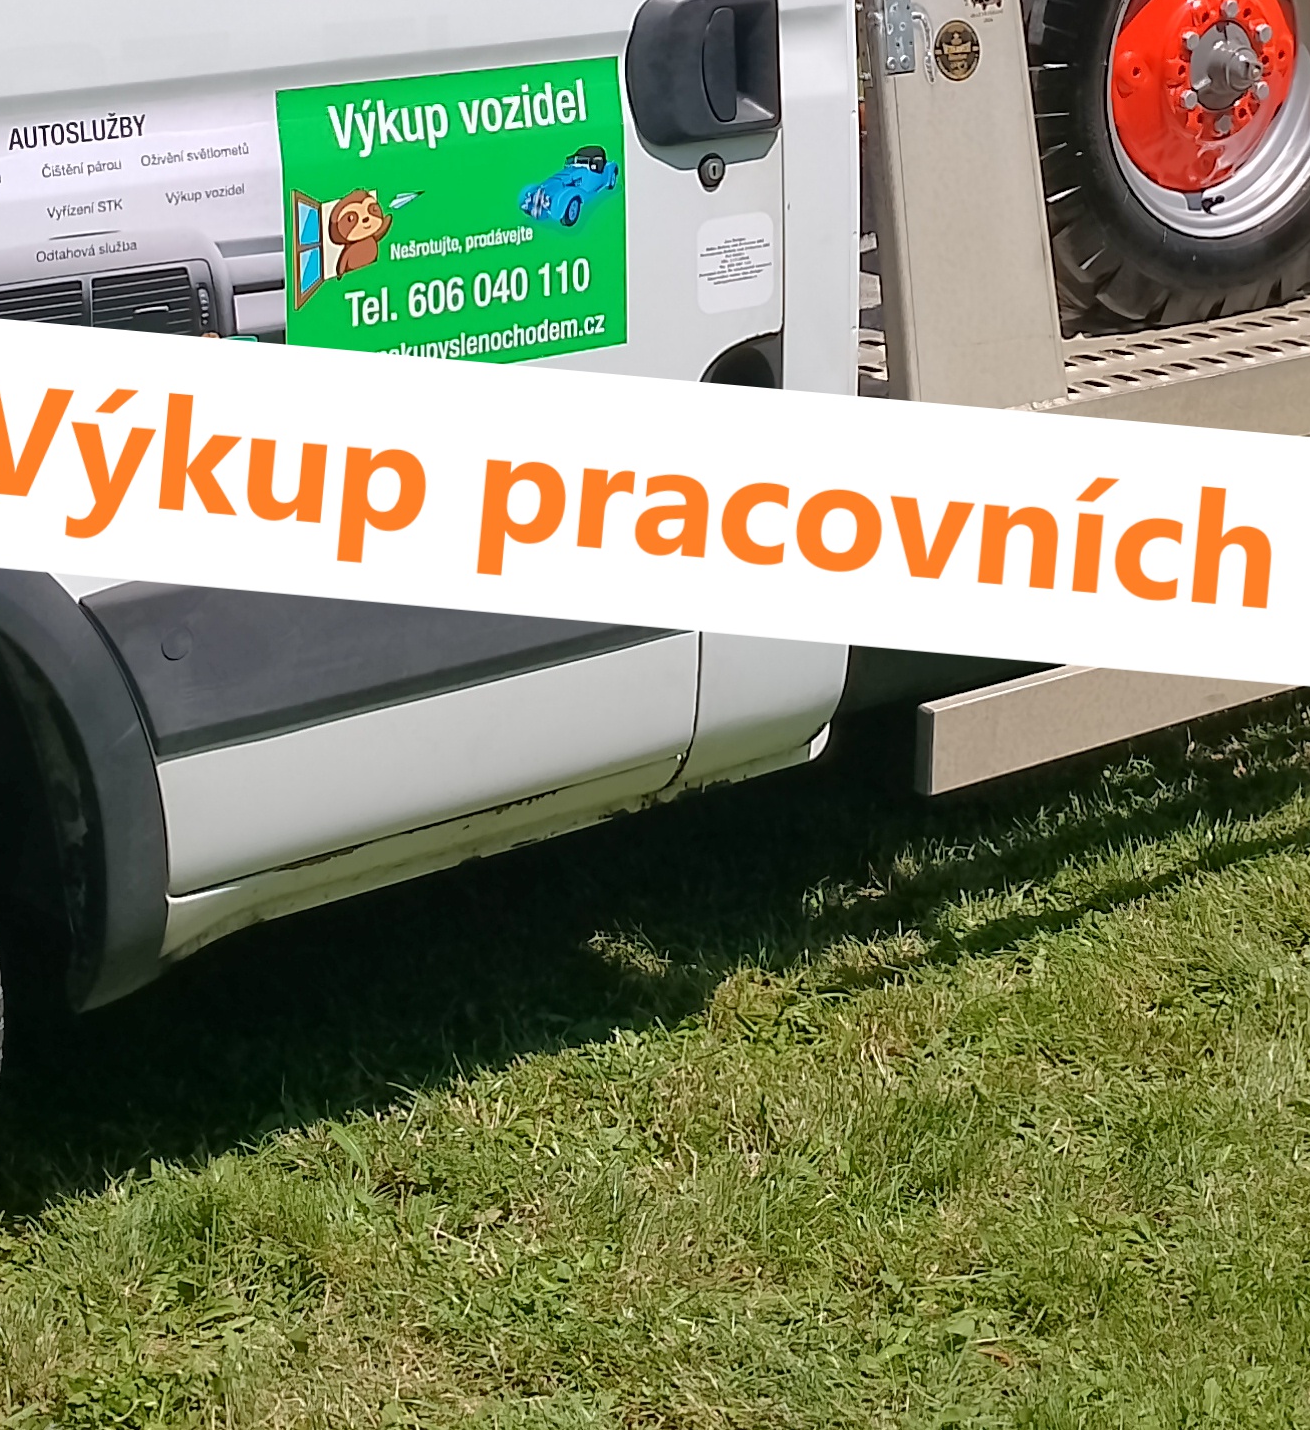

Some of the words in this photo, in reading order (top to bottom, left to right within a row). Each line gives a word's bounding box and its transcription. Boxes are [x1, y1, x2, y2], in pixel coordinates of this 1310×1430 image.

[8, 113, 146, 151] AUTOSLUŽBY
[327, 97, 449, 158] Výkup
[458, 78, 587, 136] vozidel
[41, 161, 84, 179] Čištění
[87, 159, 122, 176] párou
[140, 149, 184, 168] Oživění
[186, 142, 250, 163] světlometů
[46, 201, 94, 220] Vyřízení
[97, 198, 123, 215] STK
[165, 188, 202, 206] Výkup
[204, 182, 245, 200] vozidel
[36, 244, 96, 263] Odtahová
[99, 239, 138, 256] služba
[390, 235, 463, 261] Nešrotujte,
[465, 225, 533, 252] prodávejte
[344, 286, 398, 328] Tel.
[408, 279, 465, 319] 606
[473, 267, 529, 308] 040
[538, 258, 591, 297] 110
[376, 314, 605, 360] kupyslenochodem.cz
